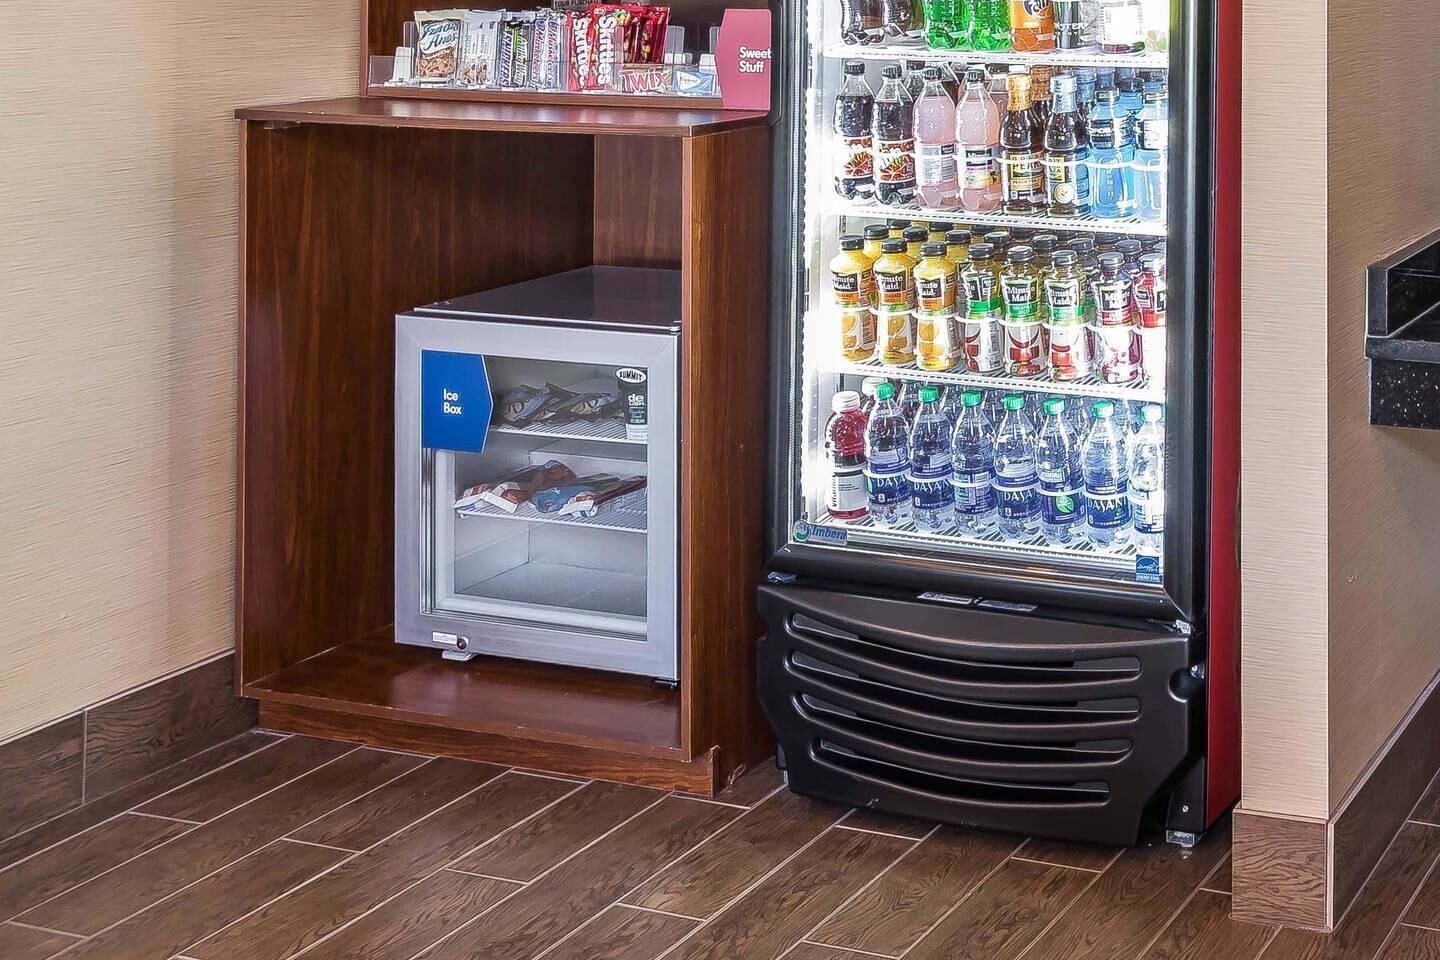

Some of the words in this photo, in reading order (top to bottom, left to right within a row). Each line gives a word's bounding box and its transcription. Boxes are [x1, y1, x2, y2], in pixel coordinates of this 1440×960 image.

[597, 14, 617, 86] Skittles
[738, 47, 772, 60] Sweet
[738, 61, 765, 74] Stuff
[619, 369, 643, 381] SUMMIT
[443, 389, 459, 401] Ice
[443, 401, 463, 415] Box
[811, 527, 847, 541] Imbera
